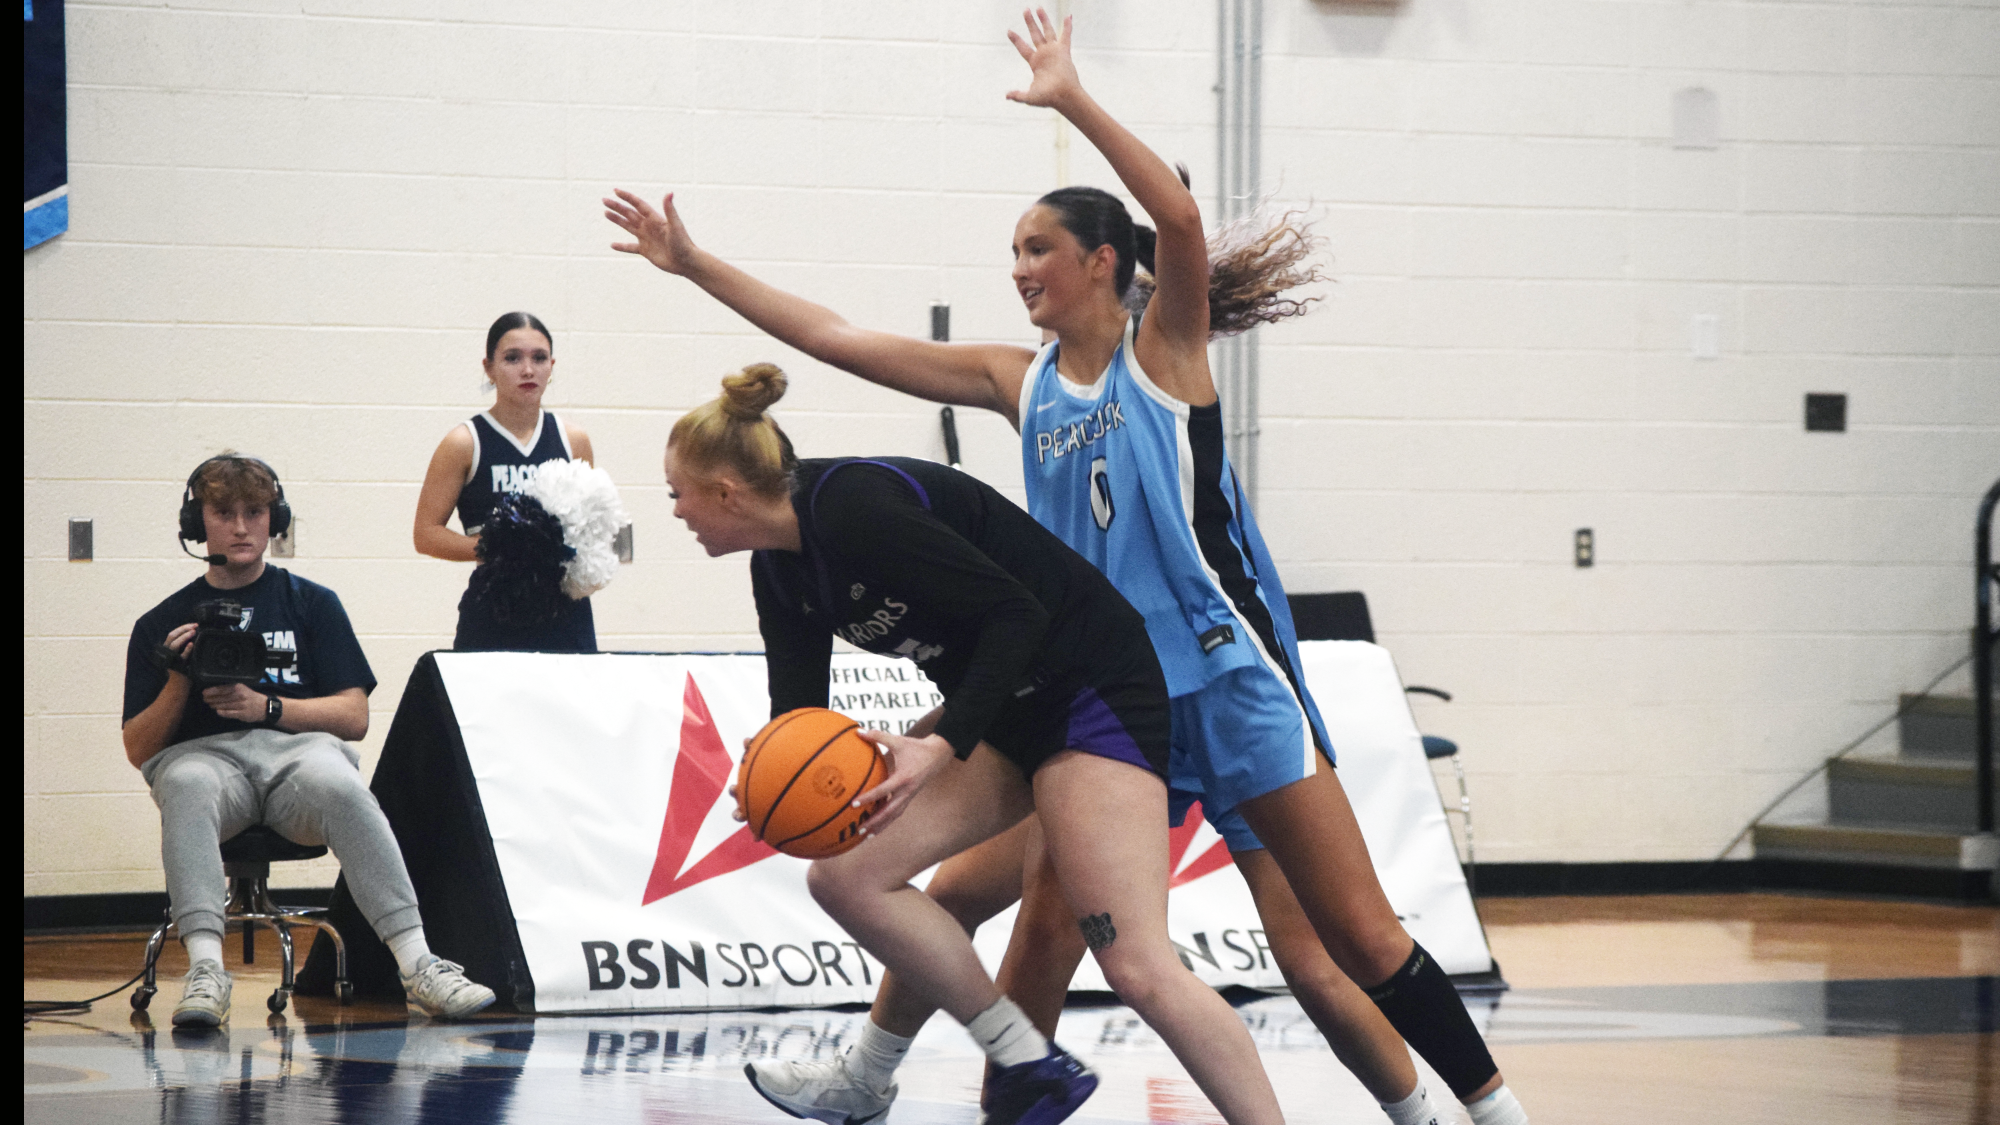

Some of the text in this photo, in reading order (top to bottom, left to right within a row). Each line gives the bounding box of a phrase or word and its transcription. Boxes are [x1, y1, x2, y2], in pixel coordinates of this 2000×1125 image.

[1088, 455, 1116, 531] 0
[831, 666, 910, 684] FFICIAL
[831, 691, 926, 711] APPAREL
[581, 938, 872, 991] BSN SPORT
